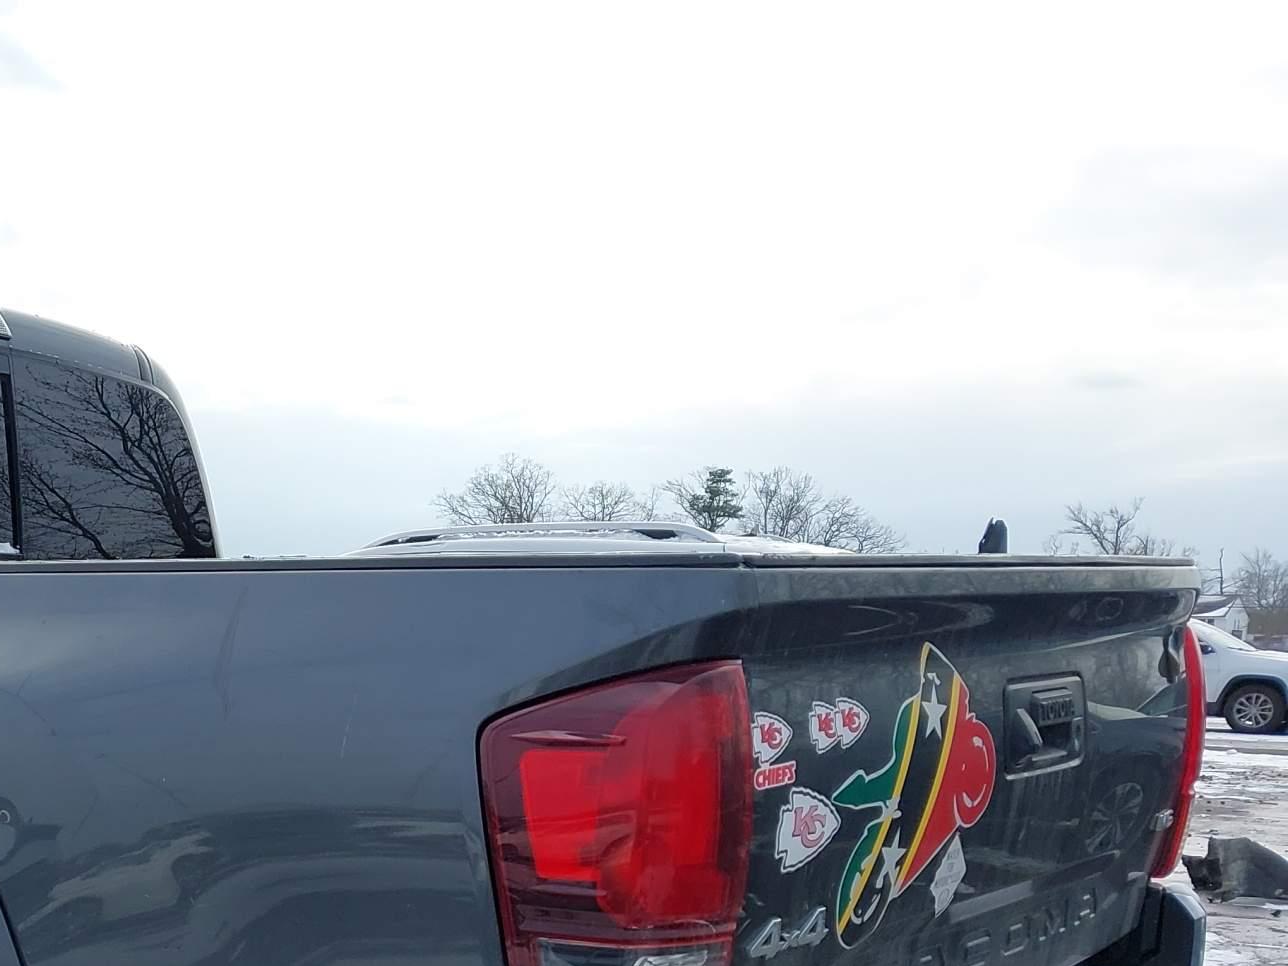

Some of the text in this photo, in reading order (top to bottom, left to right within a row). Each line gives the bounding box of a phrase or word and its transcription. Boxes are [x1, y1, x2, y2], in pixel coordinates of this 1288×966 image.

[754, 763, 796, 788] CHIEFS
[792, 804, 827, 849] KC
[750, 906, 830, 960] 4x4
